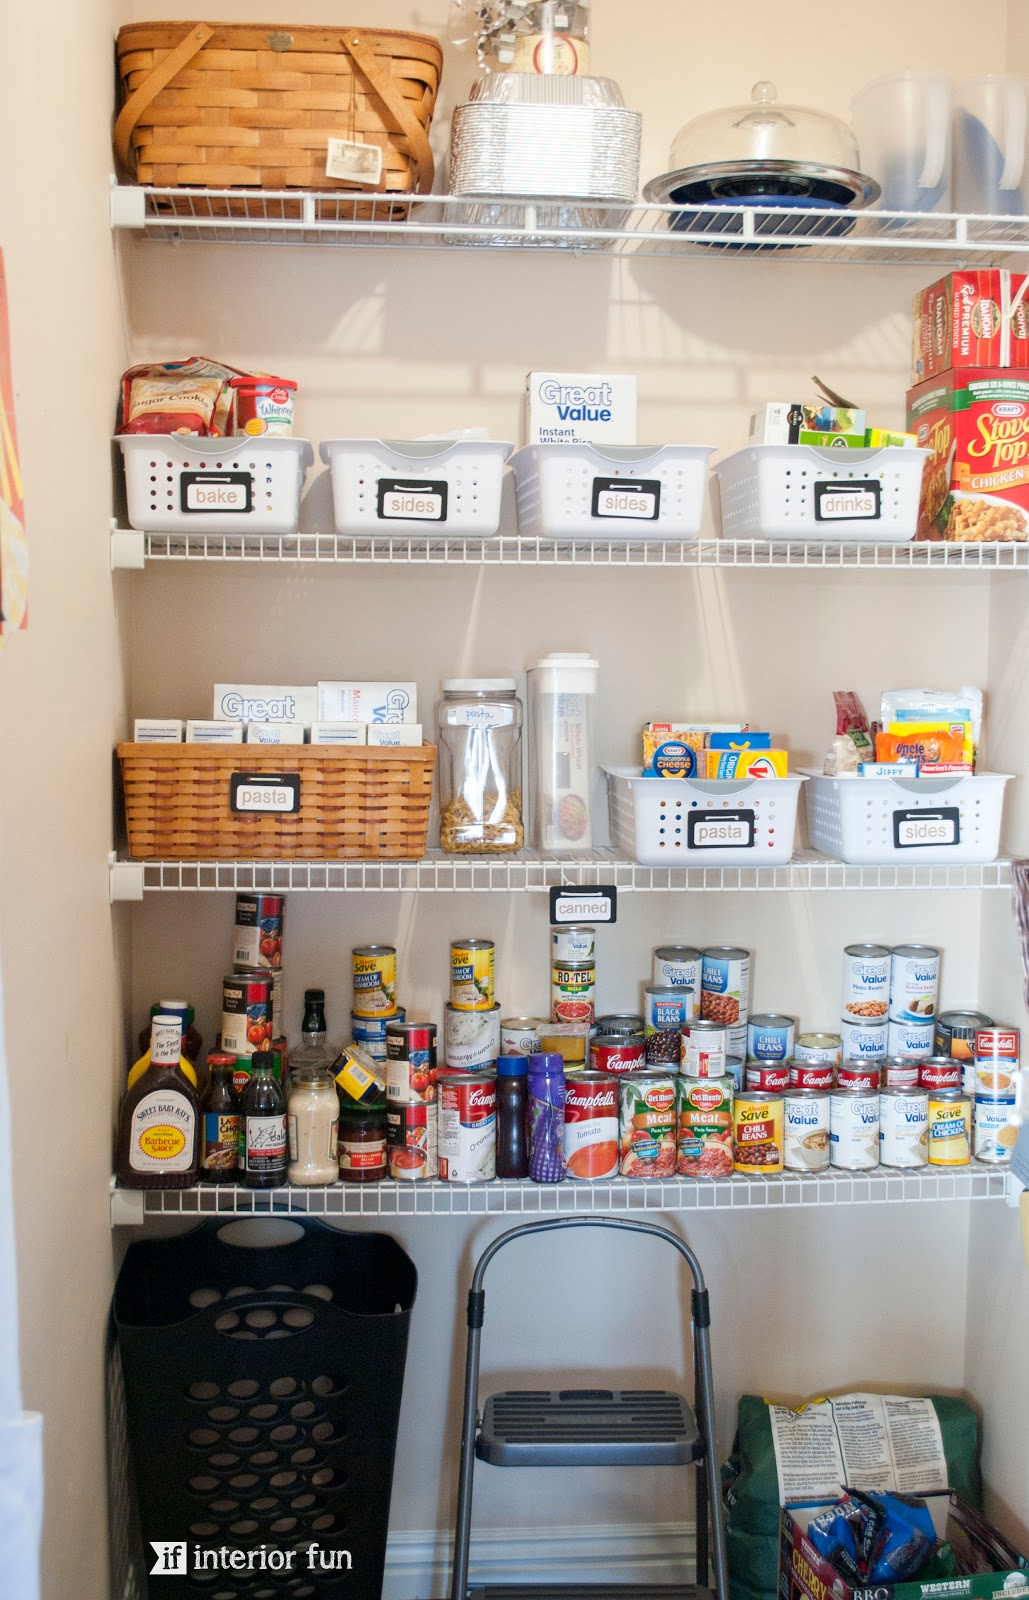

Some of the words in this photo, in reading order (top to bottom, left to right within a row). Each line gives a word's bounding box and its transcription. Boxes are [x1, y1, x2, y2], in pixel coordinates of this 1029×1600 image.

[979, 299, 992, 339] IDAHOAN
[960, 305, 971, 356] PREMIUM
[538, 380, 612, 407] Great
[557, 404, 612, 422] Value
[539, 426, 576, 437] Instant
[992, 440, 1027, 468] Top
[971, 468, 1024, 489] CHICKEN
[196, 487, 238, 504] bake
[391, 497, 435, 514] sides
[604, 497, 648, 513] sides
[825, 496, 873, 513] drinks
[221, 692, 295, 719] Great
[465, 709, 494, 721] pasta
[252, 727, 281, 738] Great
[373, 730, 401, 739] Great
[258, 736, 281, 744] Value
[379, 738, 401, 746] Value
[895, 742, 925, 755] Uncle
[876, 767, 903, 776] JIFFY
[920, 764, 948, 772] America's
[241, 788, 287, 807] pasta
[698, 824, 742, 842] pasta
[905, 824, 947, 839] sides
[558, 901, 608, 915] canned
[354, 963, 377, 972] Save
[662, 965, 696, 979] Great
[703, 966, 721, 977] CHILI
[853, 962, 888, 976] Great
[906, 961, 937, 974] Great
[369, 973, 379, 982] OF
[670, 976, 696, 986] Value
[861, 975, 888, 984] Value
[914, 973, 937, 981] Value
[657, 1008, 680, 1016] BLACK
[657, 1015, 681, 1023] BEANS
[759, 1035, 781, 1044] CHILI
[850, 1030, 885, 1044] Great
[898, 1029, 931, 1042] Great
[757, 1043, 783, 1052] BEANS
[858, 1043, 885, 1052] Value
[906, 1041, 931, 1049] Value
[648, 1094, 659, 1102] Del
[659, 1093, 674, 1102] Monte
[691, 1093, 702, 1101] Del
[702, 1093, 722, 1102] Monte
[136, 1105, 157, 1122] SWEET
[157, 1104, 175, 1113] BABY
[175, 1107, 192, 1123] RAY'S
[646, 1112, 673, 1125] Meat
[690, 1112, 719, 1124] Meat
[740, 1109, 769, 1122] Save
[935, 1109, 962, 1120] Save
[986, 1115, 1008, 1123] Value
[220, 1117, 232, 1126] LA
[787, 1114, 818, 1125] Value
[932, 1121, 957, 1131] CREAM
[956, 1119, 965, 1127] OF
[577, 1126, 602, 1139] Tomato
[743, 1124, 765, 1134] CHILI
[933, 1127, 964, 1137] CHICKEN
[144, 1137, 180, 1145] Barbecue
[741, 1131, 768, 1141] BEANS
[151, 1144, 174, 1153] Sauce
[793, 1548, 827, 1600] CHERRY
[920, 1579, 971, 1593] WESTERN
